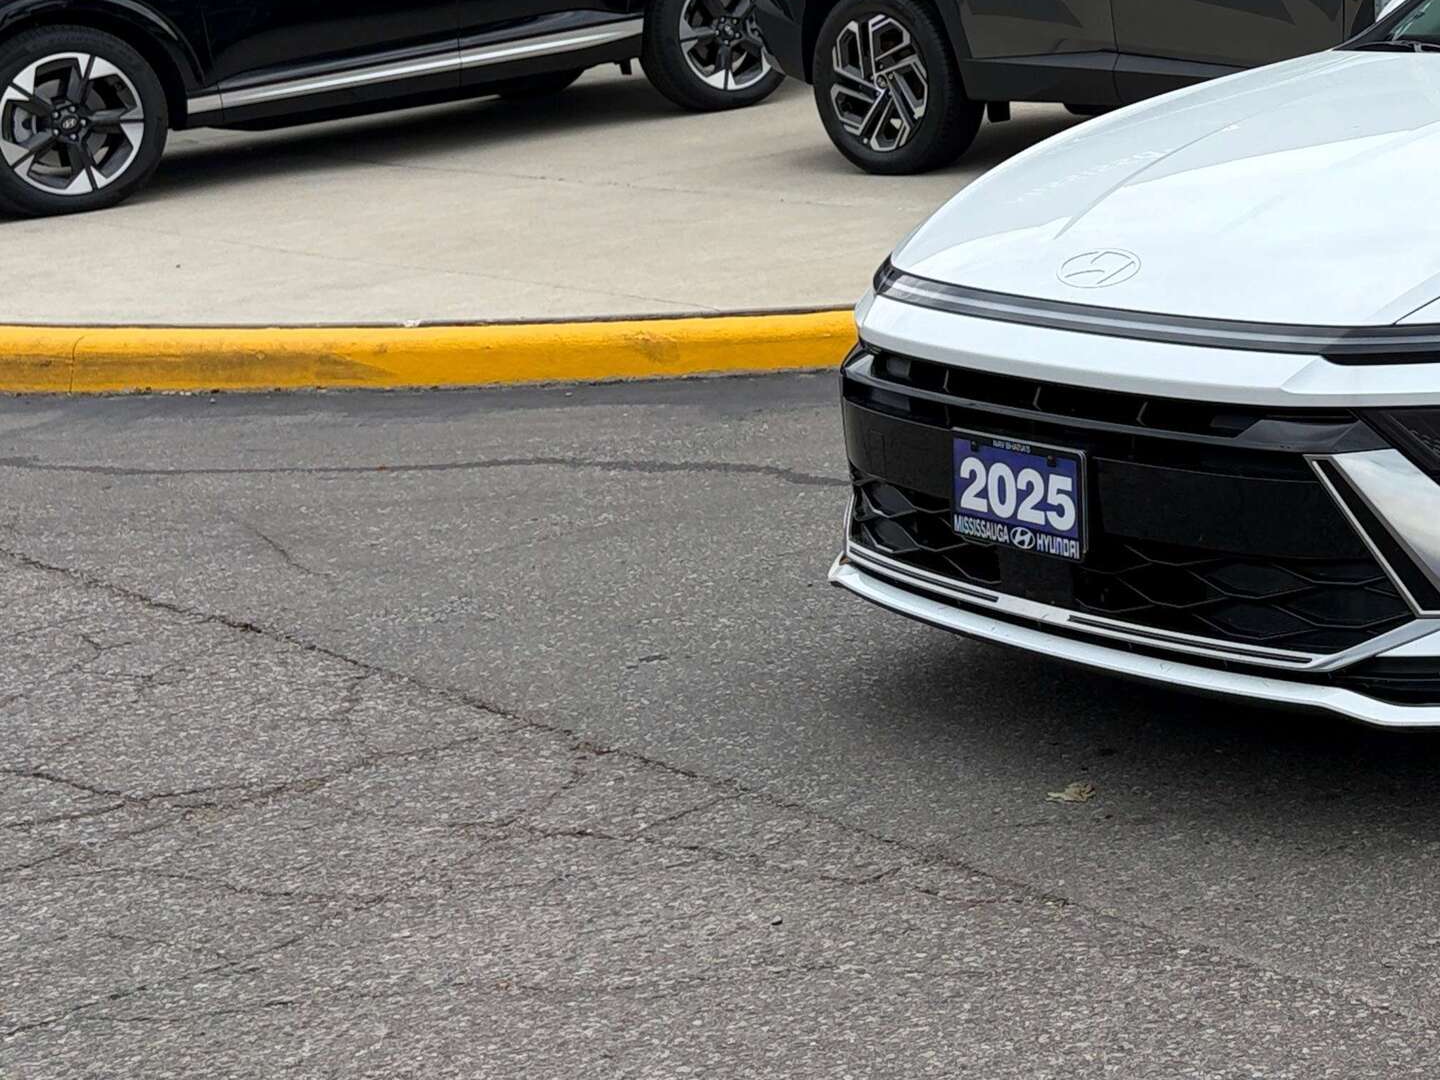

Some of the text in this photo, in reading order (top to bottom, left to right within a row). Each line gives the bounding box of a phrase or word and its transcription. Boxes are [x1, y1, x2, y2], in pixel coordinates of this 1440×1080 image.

[960, 457, 1076, 531] 2025
[953, 513, 1080, 559] MISSISSAUGA HYUNDAI
